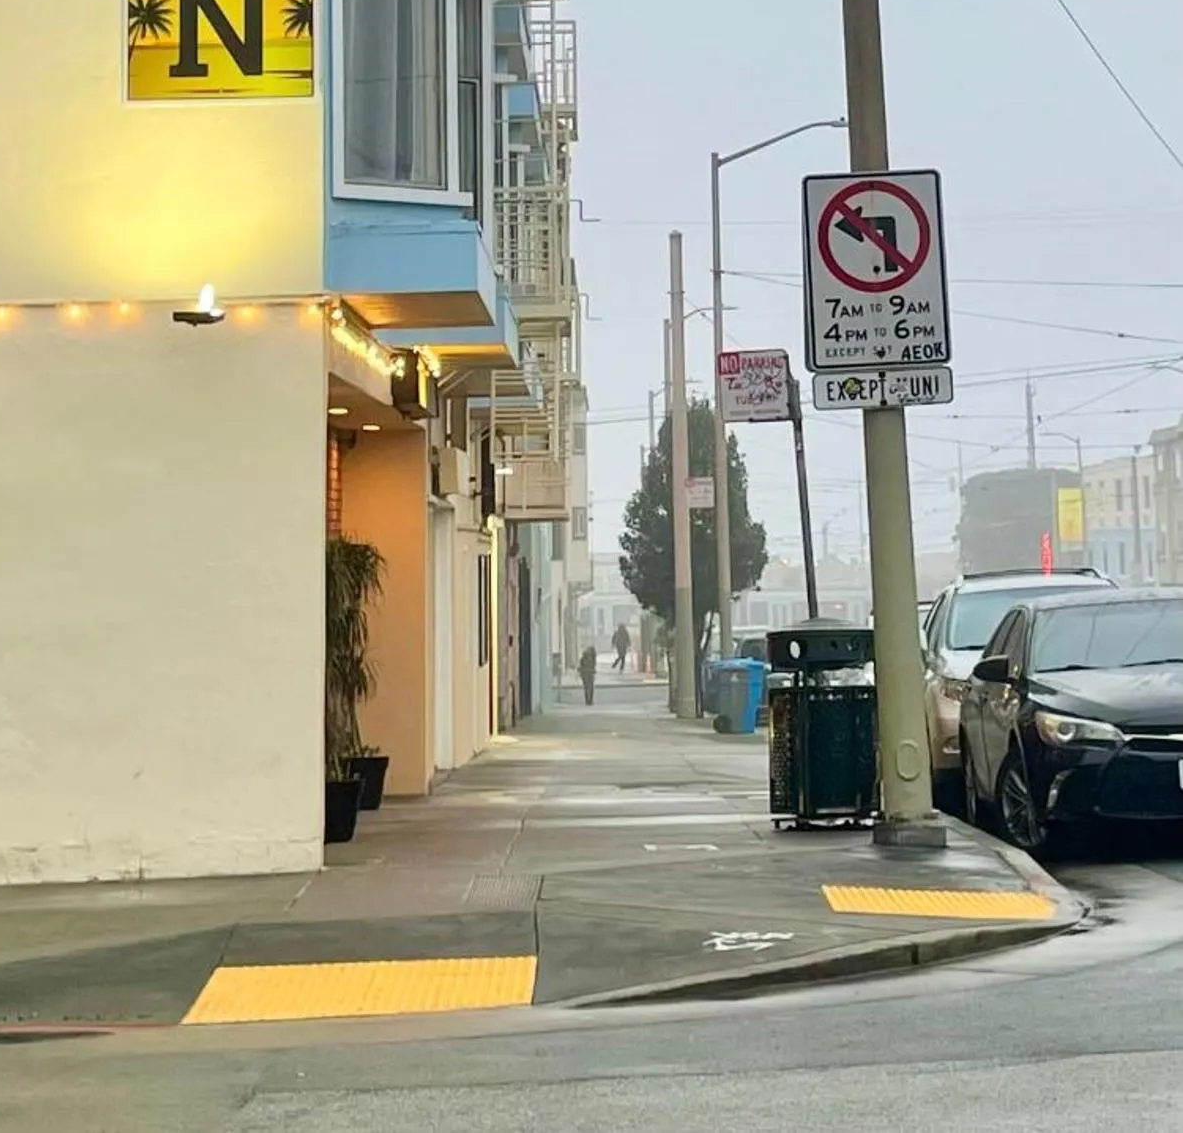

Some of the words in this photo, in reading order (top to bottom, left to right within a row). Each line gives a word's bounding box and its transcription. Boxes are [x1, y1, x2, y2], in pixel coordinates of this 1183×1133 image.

[824, 297, 864, 319] 7AM
[869, 303, 883, 314] TO
[888, 294, 931, 316] 9AM
[874, 326, 887, 338] TO
[825, 347, 866, 359] EXCEPT
[720, 354, 738, 375] NO
[896, 374, 939, 397] UNI
